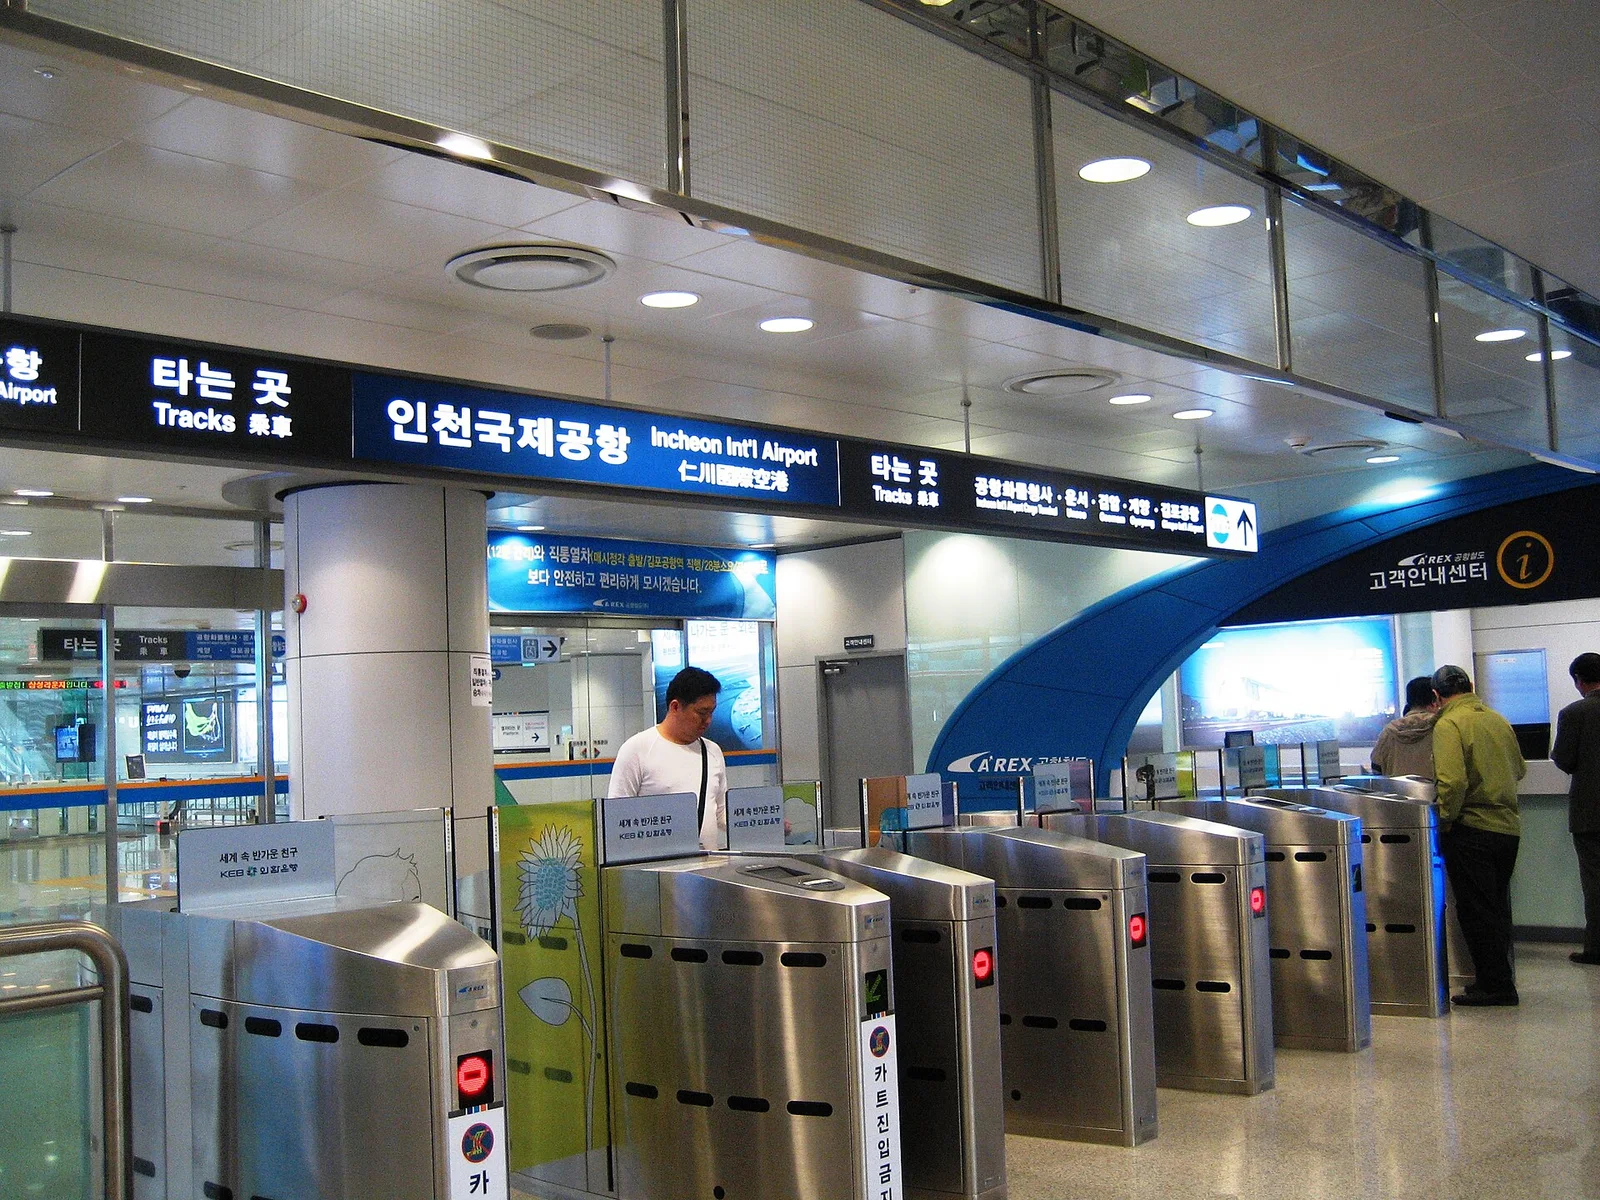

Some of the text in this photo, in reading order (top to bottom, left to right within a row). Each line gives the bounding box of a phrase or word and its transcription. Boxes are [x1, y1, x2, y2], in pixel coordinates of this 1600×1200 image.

[151, 356, 293, 408] 타는 곳
[152, 401, 237, 433] Tracks
[386, 397, 631, 467] 인천국제공항
[650, 424, 819, 469] Incheon Int'l Airport
[870, 454, 938, 486] 타는 곳
[872, 484, 913, 506] Tracks
[527, 568, 703, 594] 보다 안전하고 편리하게 모시겠습니다.
[1369, 561, 1488, 590] 고객안내센터
[64, 637, 98, 652] 타는
[139, 635, 168, 645] Tracks
[640, 816, 659, 827] 반가운
[660, 815, 672, 825] 친구
[752, 805, 769, 815] 반가운
[769, 804, 780, 814] 친구
[619, 832, 636, 840] KEB
[219, 847, 298, 864] 세계 속 반가운 친구
[220, 863, 298, 879] KEB 외환은행
[469, 1169, 489, 1195] 카
